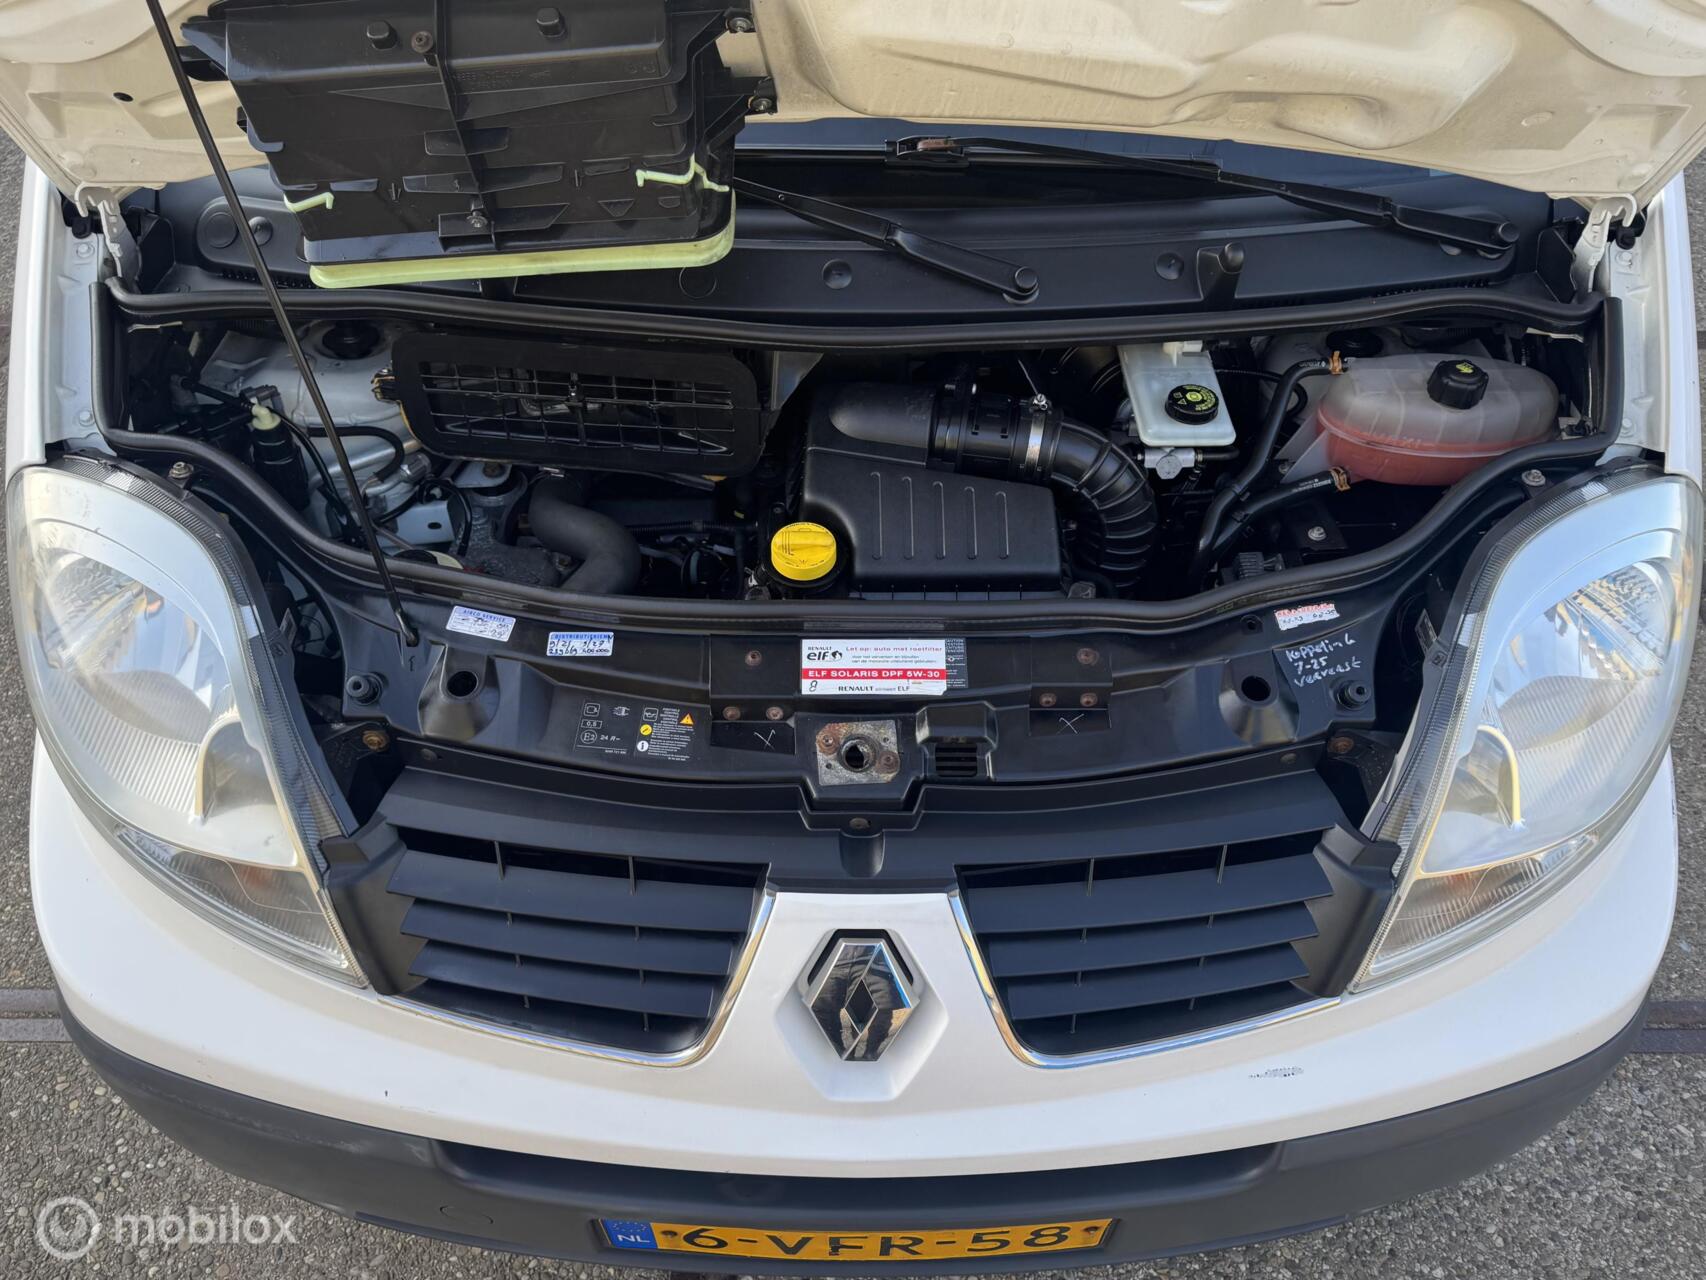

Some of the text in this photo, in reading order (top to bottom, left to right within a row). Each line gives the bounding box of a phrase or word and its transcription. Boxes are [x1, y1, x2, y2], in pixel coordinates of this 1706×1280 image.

[806, 650, 830, 661] elf
[615, 1225, 1072, 1257] NL 6-VFR-58
